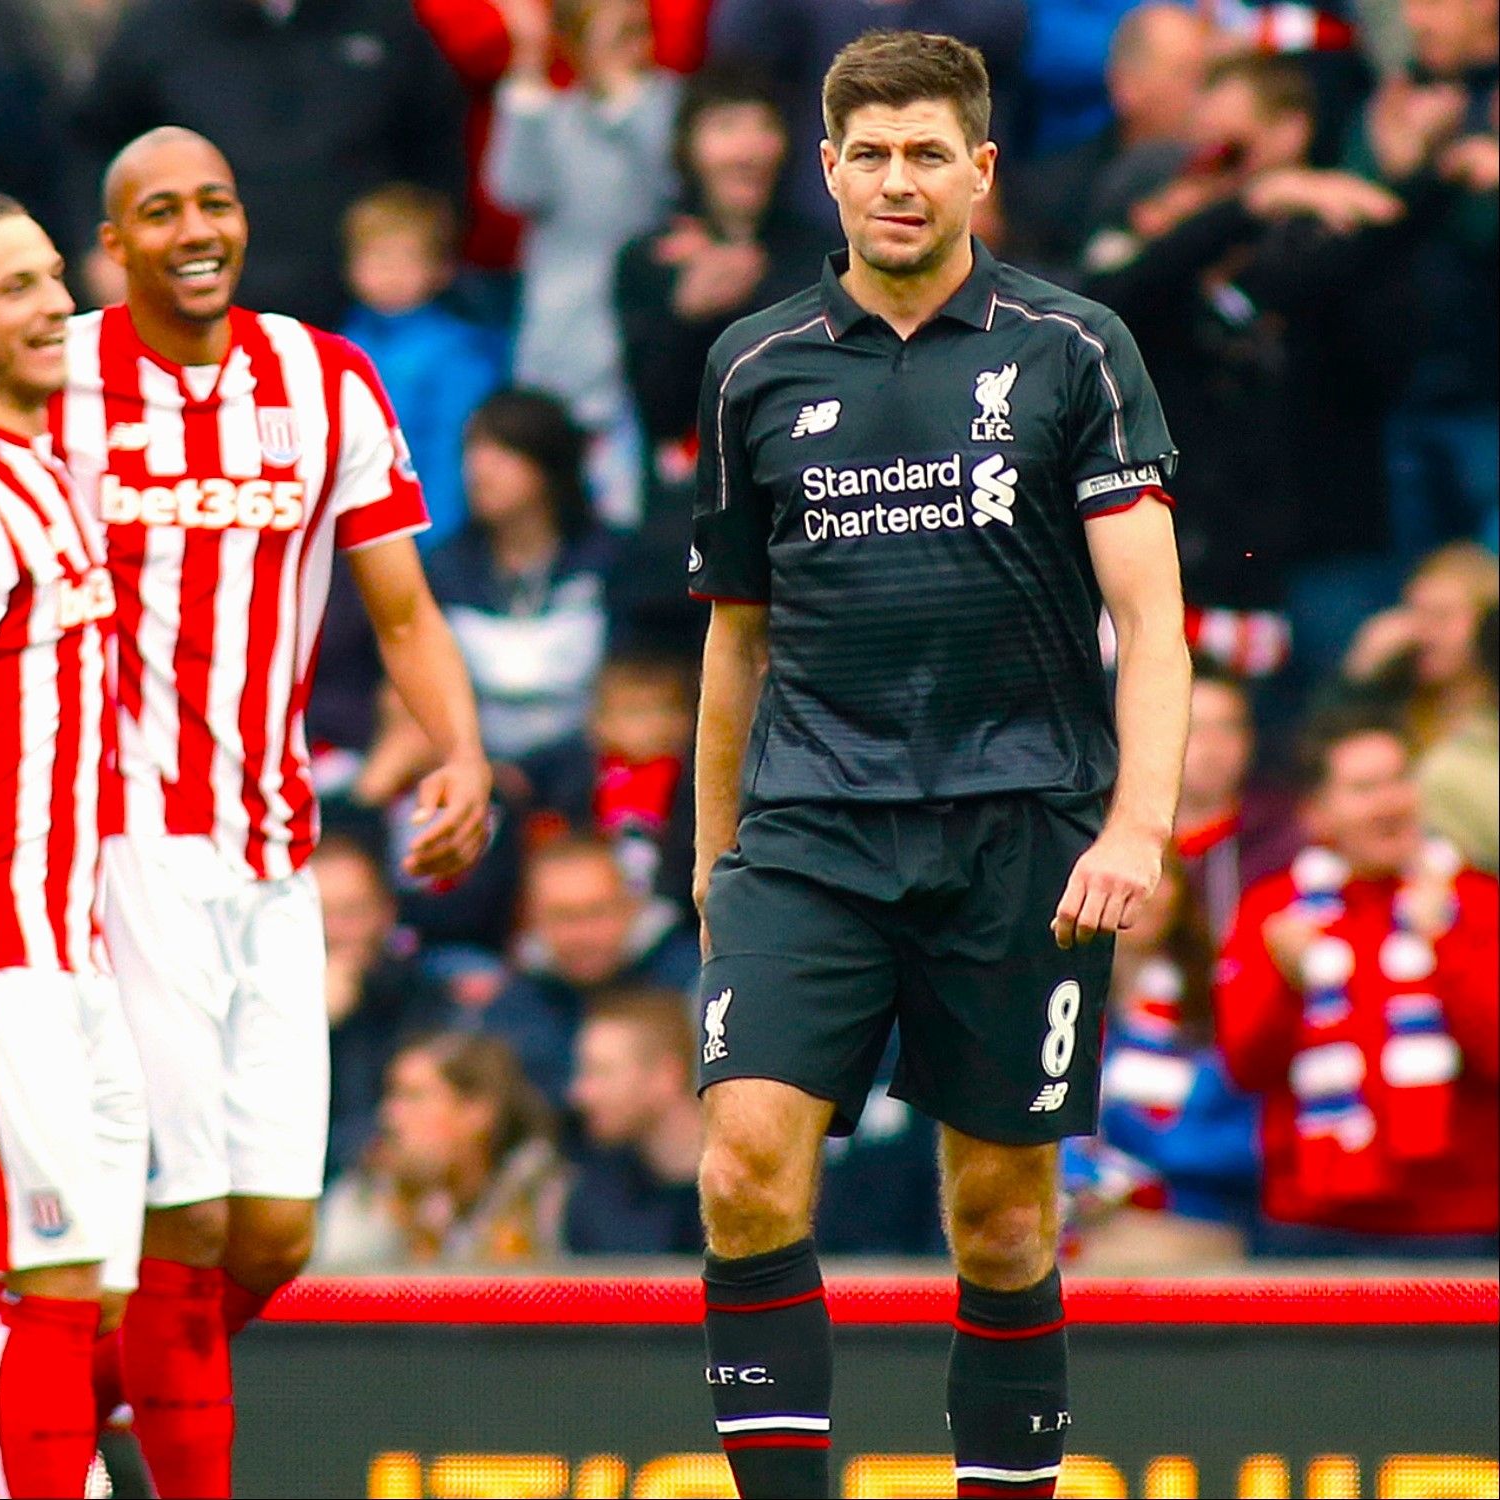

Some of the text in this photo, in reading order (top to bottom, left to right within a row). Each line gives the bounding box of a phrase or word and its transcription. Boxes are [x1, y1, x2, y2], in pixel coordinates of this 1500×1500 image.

[100, 474, 305, 531] bet365
[802, 453, 961, 501] Standard
[803, 494, 965, 542] Chartered
[1041, 979, 1082, 1079] 8
